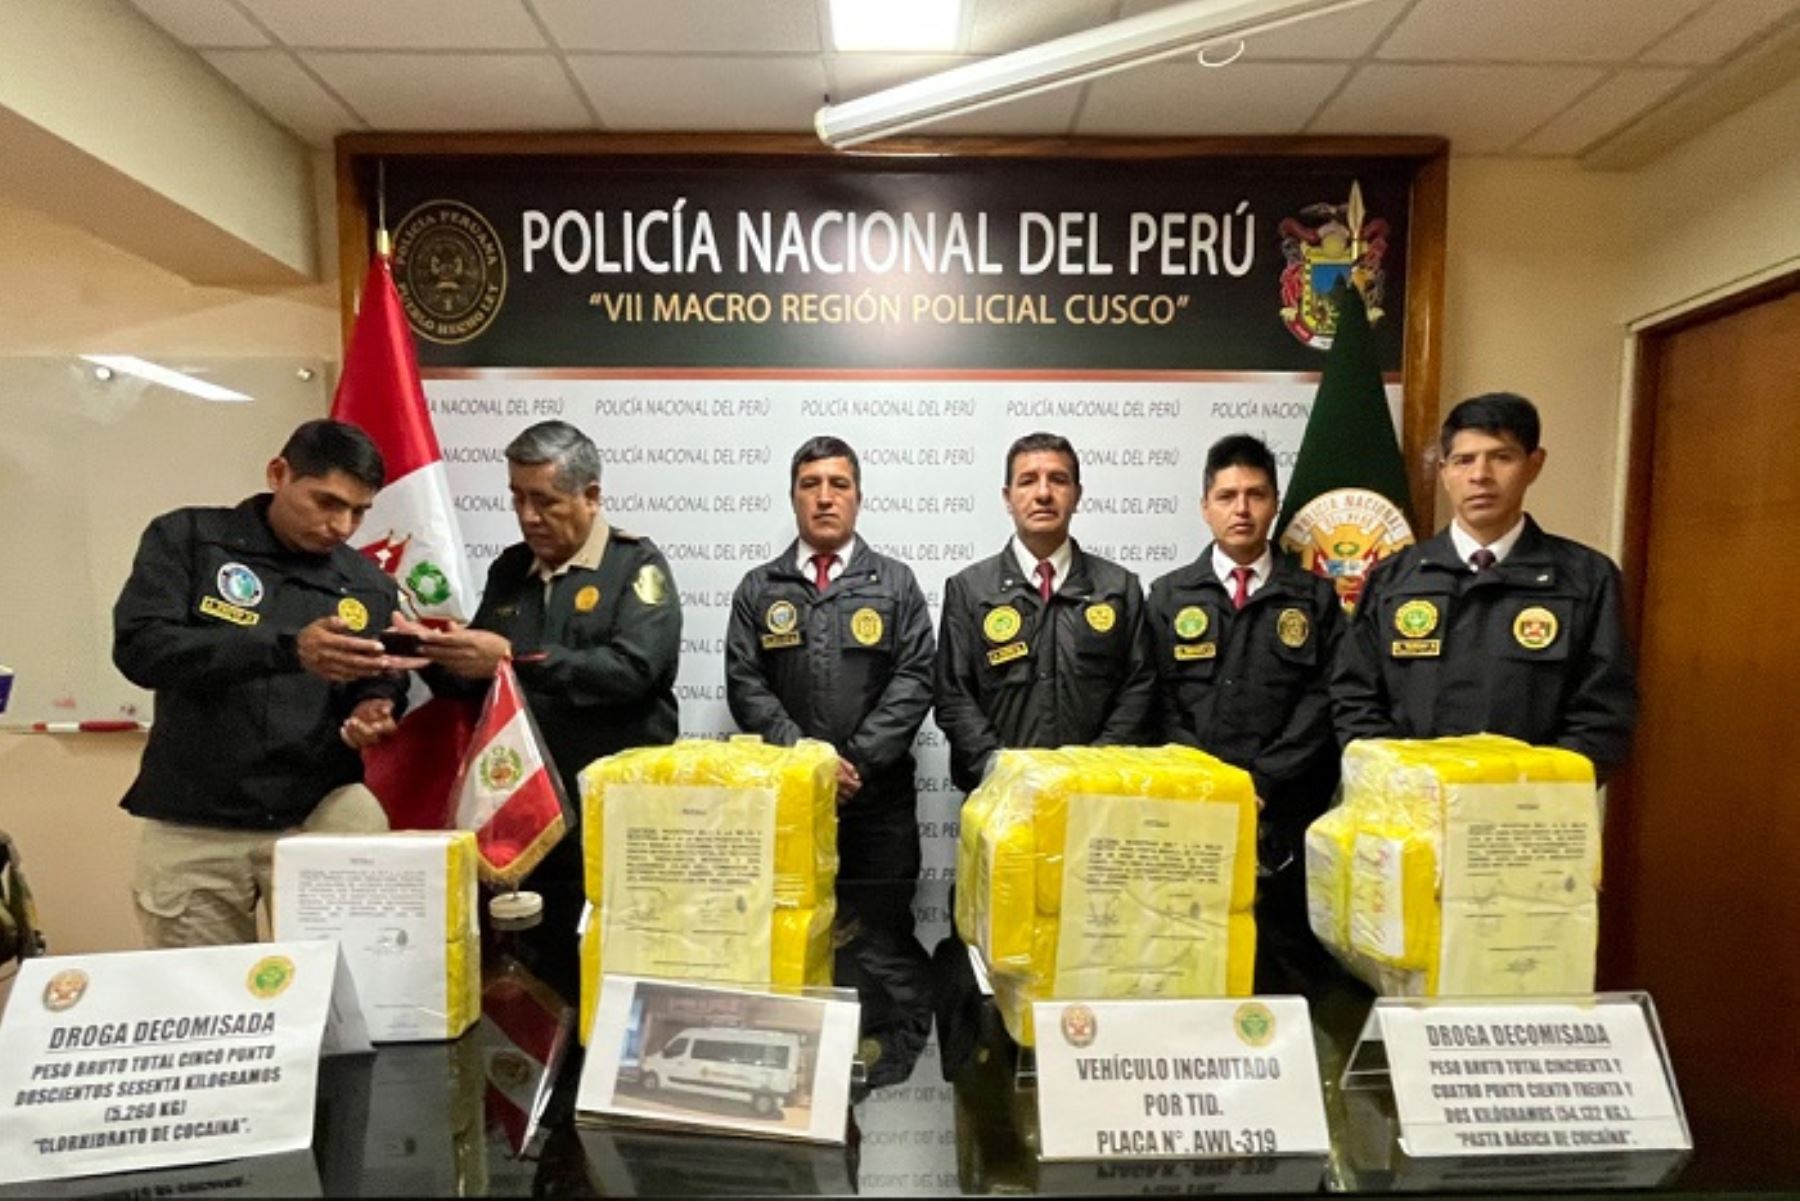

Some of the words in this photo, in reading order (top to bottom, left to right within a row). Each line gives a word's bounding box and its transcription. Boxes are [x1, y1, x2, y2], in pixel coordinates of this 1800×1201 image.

[522, 197, 722, 274] POLICÍA
[737, 210, 1003, 275] NACIONAL
[1019, 211, 1112, 275] DEL
[1129, 201, 1255, 276] PERÚ
[652, 292, 772, 322] MACRO
[782, 286, 902, 322] REGIÓN
[912, 293, 1057, 324] POLICIAL
[440, 399, 502, 415] NACIONAL
[506, 400, 528, 416] DEL
[533, 396, 565, 416] PERÚ
[595, 397, 643, 417] POLICÍA
[645, 400, 707, 417] NACIONAL
[711, 400, 734, 417] DEL
[738, 396, 771, 417] PERÚ
[801, 397, 848, 417] POLICÍA
[851, 400, 914, 417] NACIONAL
[917, 400, 940, 417] DEL
[943, 397, 976, 417] PERÚ
[1006, 398, 1053, 418] POLICÍA
[1057, 401, 1120, 418] NACIONAL
[1122, 401, 1146, 418] DEL
[1148, 398, 1181, 418] PERÚ
[1210, 399, 1257, 419] POLICÍA
[1261, 402, 1309, 419] NACION
[645, 448, 707, 465] NACIONAL
[711, 448, 734, 465] DEL
[738, 444, 771, 465] PERÚ
[863, 448, 914, 465] ACIONAL
[917, 448, 940, 465] DEL
[943, 445, 975, 465] PERÚ
[1121, 449, 1144, 466] DEL
[1147, 446, 1180, 466] PERÚ
[453, 495, 506, 511] ACIONAL
[645, 496, 707, 512] NACIONAL
[711, 496, 734, 512] DEL
[738, 492, 771, 512] PERÚ
[863, 496, 914, 513] ACIONAL
[917, 496, 940, 513] DEL
[943, 494, 975, 513] PERÚ
[1120, 497, 1144, 514] DEL
[1146, 495, 1178, 514] PERÚ
[713, 543, 737, 560] DEL
[739, 541, 771, 560] PERÚ
[917, 544, 940, 560] DEL
[943, 541, 974, 560] PERÚ
[1119, 544, 1143, 561] DEL
[1146, 542, 1178, 561] PERÚ
[49, 1022, 128, 1049] DROGA
[132, 1011, 276, 1043] DECOMISADA
[1426, 1024, 1491, 1047] DROGA
[1492, 1023, 1612, 1046] DECOMISADA
[31, 1060, 72, 1080] PESO
[75, 1057, 127, 1077] BRUTO
[131, 1054, 176, 1073] TOTAL
[178, 1050, 224, 1069] CINCO
[226, 1045, 276, 1064] PUNTO
[1076, 1053, 1168, 1081] VEHÍCULO
[1173, 1057, 1281, 1081] INCAUTADO
[1429, 1060, 1461, 1075] PESO
[1506, 1059, 1544, 1075] TOTAL
[14, 1083, 113, 1107] DOSCIENTOS
[116, 1076, 181, 1097] SESENTA
[184, 1066, 282, 1090] KILOGRAMOS
[1431, 1083, 1483, 1099] CUATRO
[1484, 1083, 1525, 1098] PUNTO
[159, 1099, 188, 1117] KG)
[1144, 1093, 1183, 1117] POR
[1186, 1093, 1225, 1117] TID.
[1444, 1107, 1472, 1123] DOS
[151, 1125, 171, 1143] DE
[1097, 1130, 1160, 1155] PLACA
[1193, 1128, 1277, 1153] AWL-319
[1552, 1130, 1571, 1146] DE
